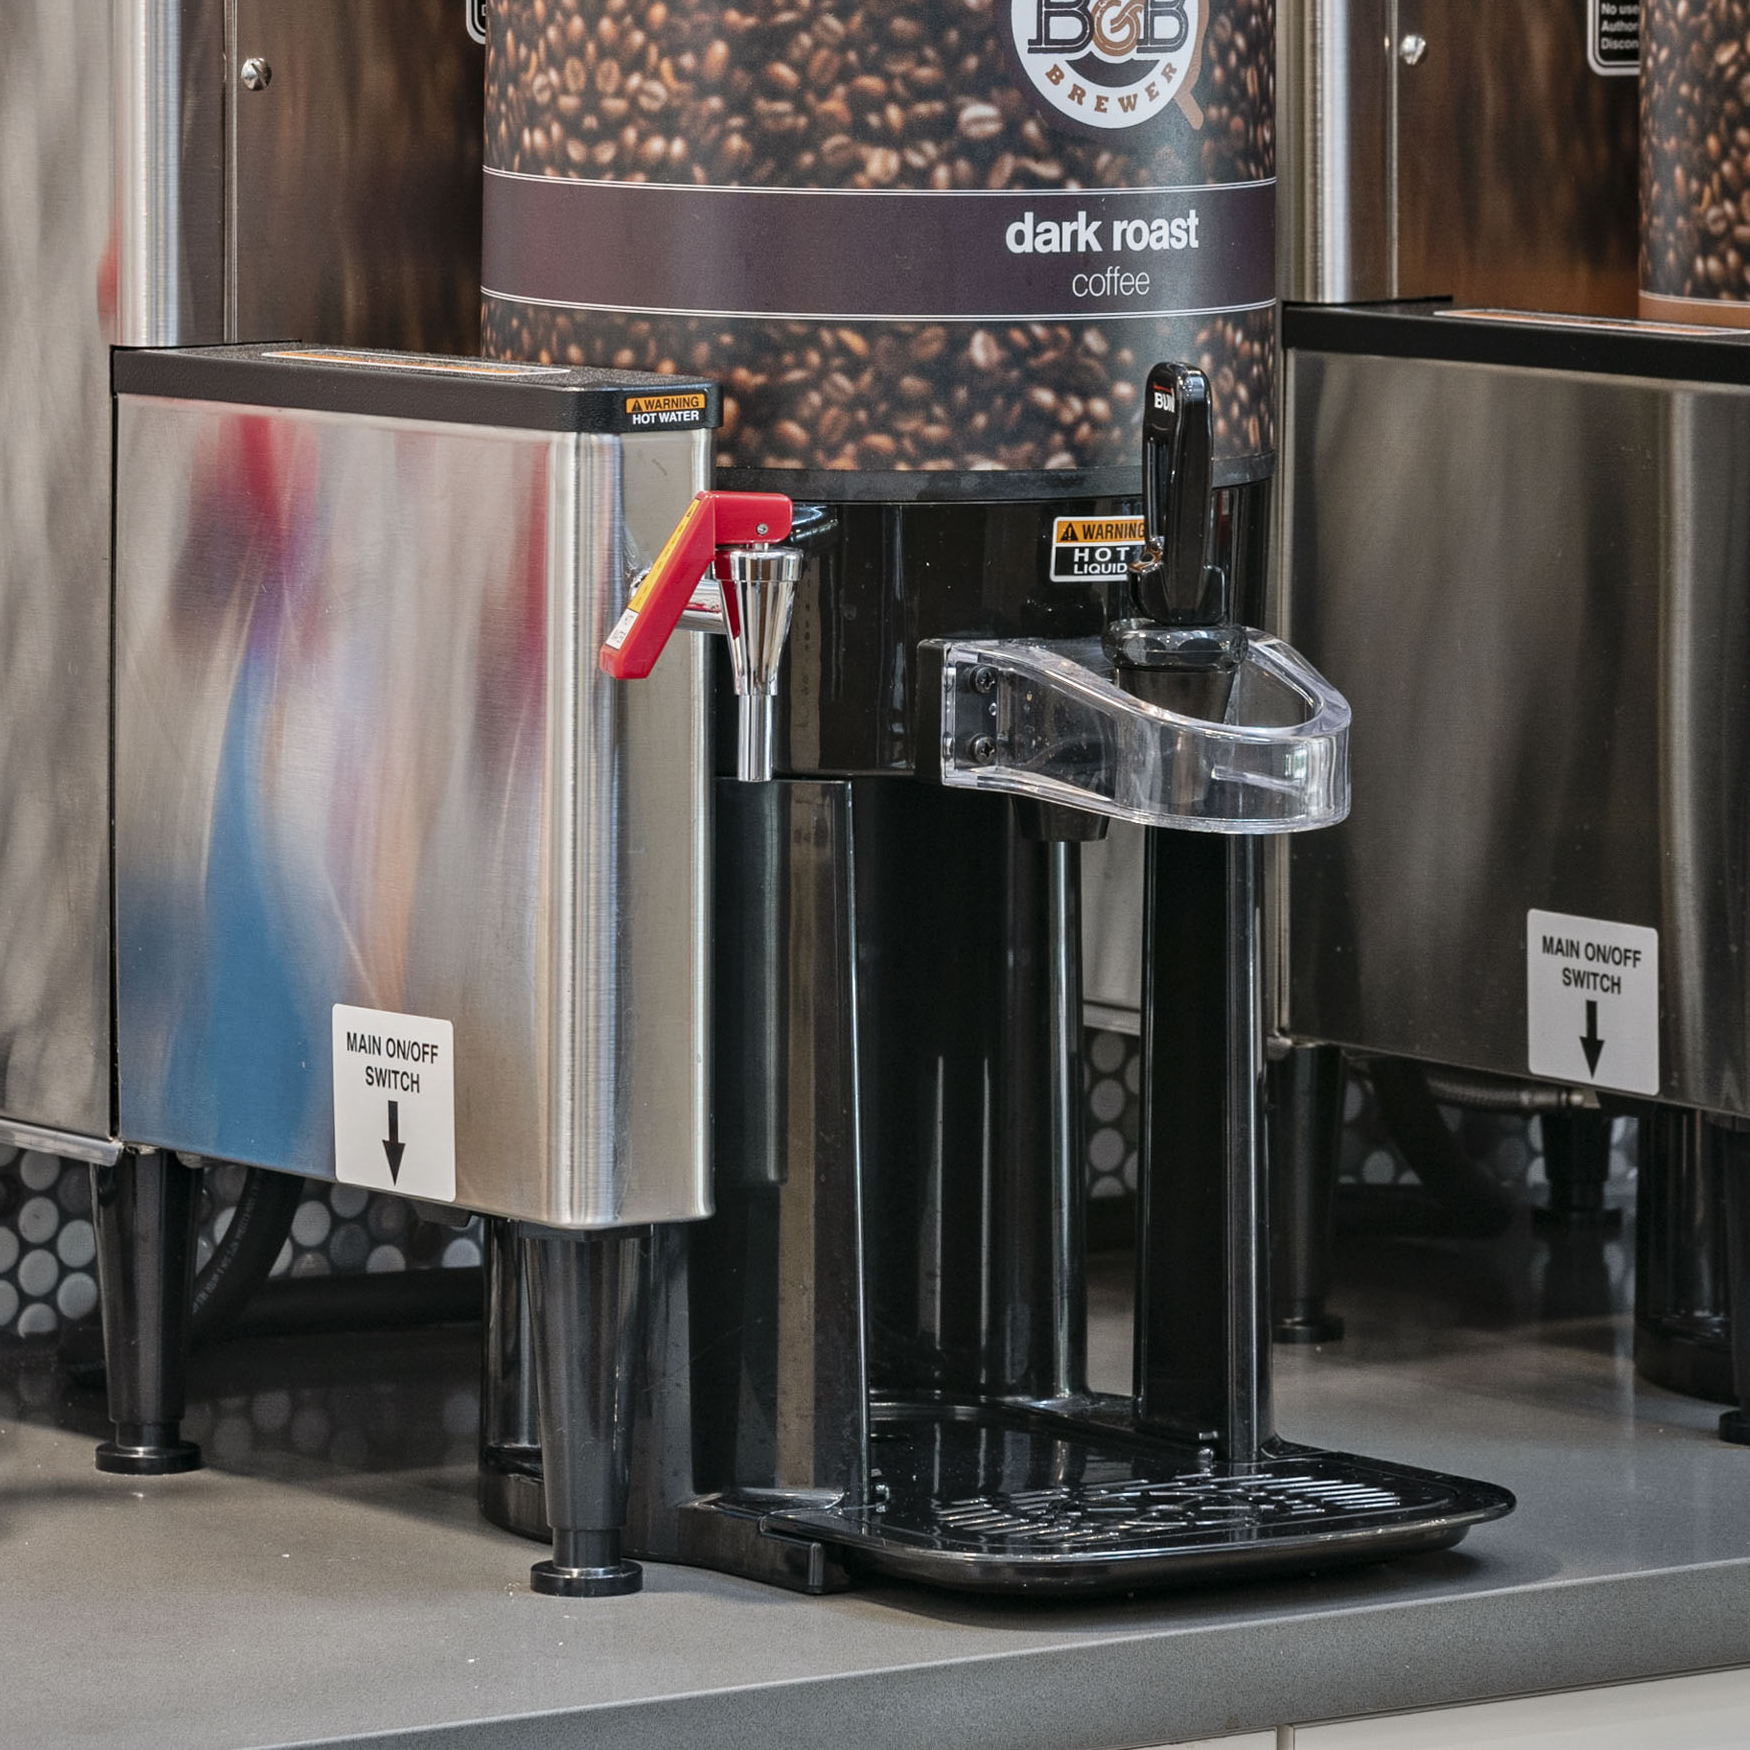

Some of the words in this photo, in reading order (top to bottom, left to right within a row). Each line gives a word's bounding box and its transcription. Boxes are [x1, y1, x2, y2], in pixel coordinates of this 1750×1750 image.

[1044, 61, 1179, 116] BREWER
[1004, 210, 1104, 254] dark
[1112, 208, 1200, 252] roast
[1071, 265, 1151, 298] coffee
[643, 396, 700, 411] WARNING
[631, 412, 658, 426] HOT
[658, 410, 700, 424] WATER
[1081, 522, 1146, 541] WARNING
[1072, 546, 1131, 563] HOT
[1072, 563, 1129, 575] LIQUID
[1542, 935, 1580, 960] MAIN
[1584, 941, 1642, 969] ON/OFF
[1561, 967, 1622, 995] SWITCH
[346, 1031, 382, 1057] MAIN
[385, 1037, 440, 1065] ON/OFF
[364, 1066, 421, 1094] SWITCH
